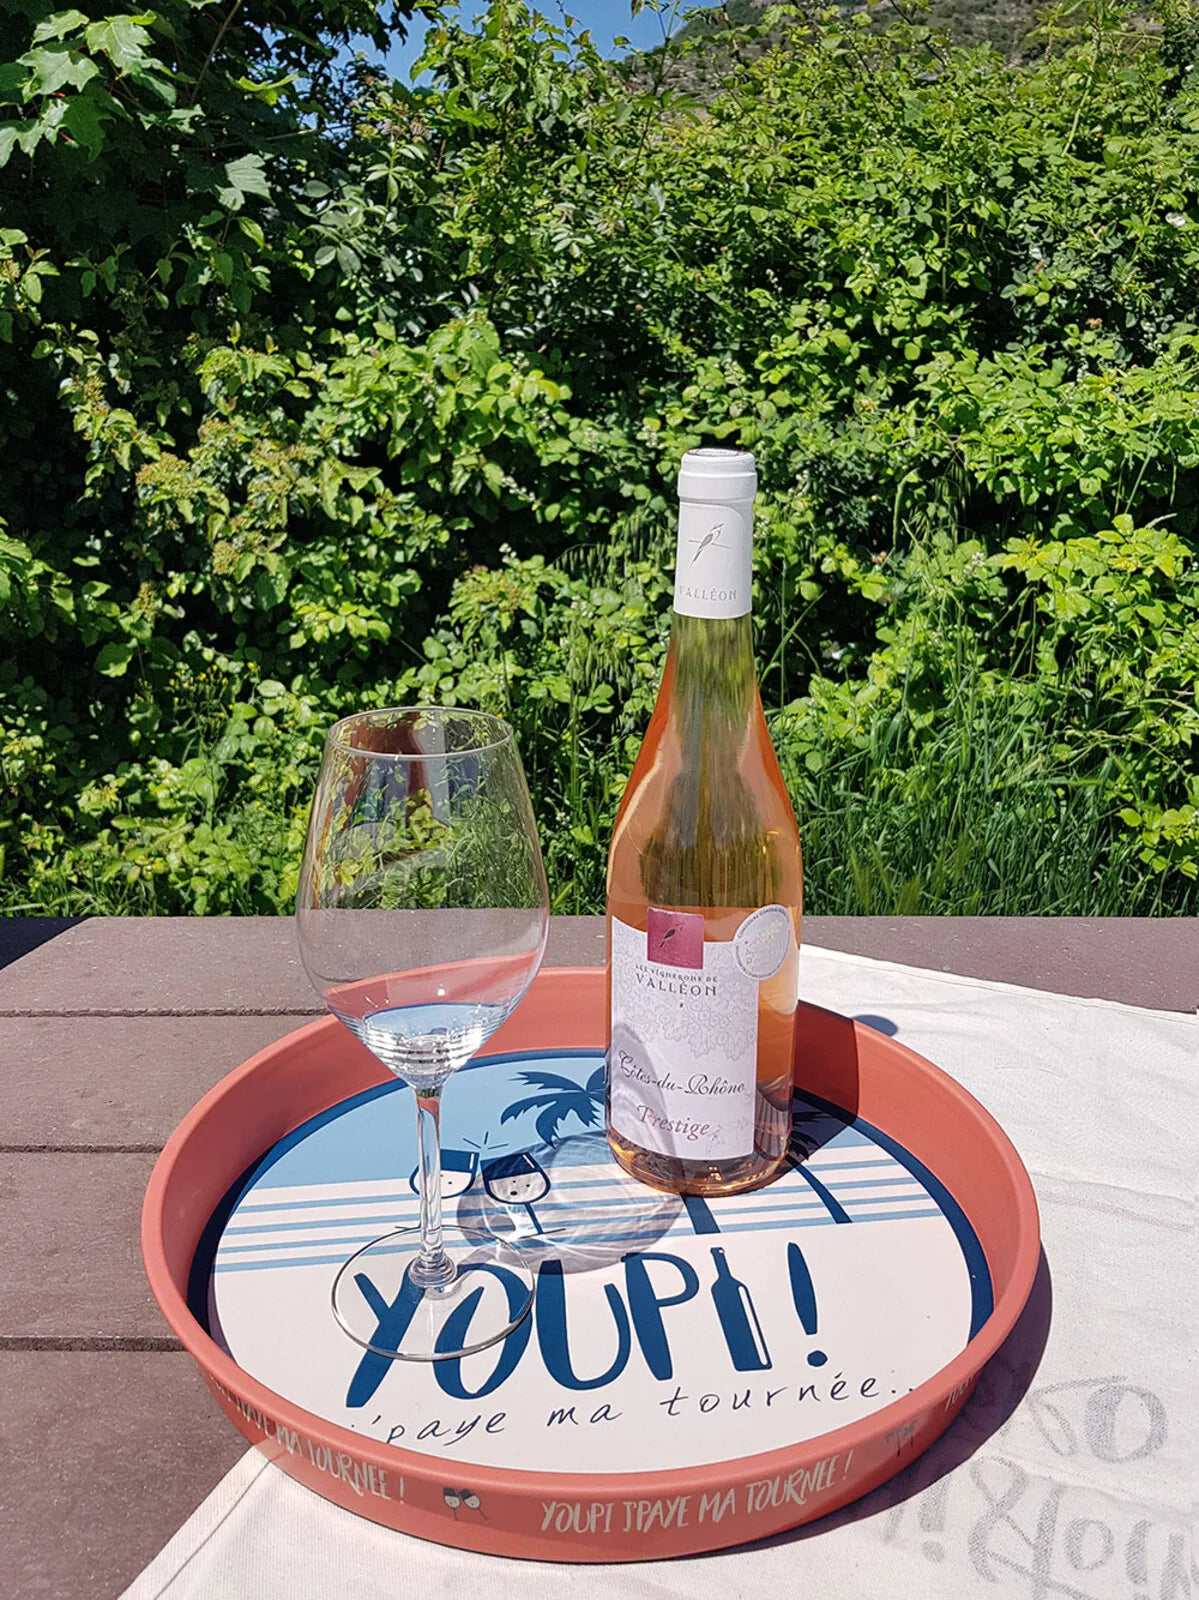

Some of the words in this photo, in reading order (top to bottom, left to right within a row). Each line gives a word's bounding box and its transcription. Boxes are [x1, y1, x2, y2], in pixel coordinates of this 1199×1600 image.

[677, 583, 738, 602] VALLÉON
[635, 971, 717, 997] VALLÉON
[618, 1050, 748, 1096] Côtes-du-Rhône
[636, 1104, 711, 1140] Prestige
[547, 1404, 623, 1427] ma
[541, 1500, 615, 1534] YOUPI
[698, 1487, 736, 1524] MA
